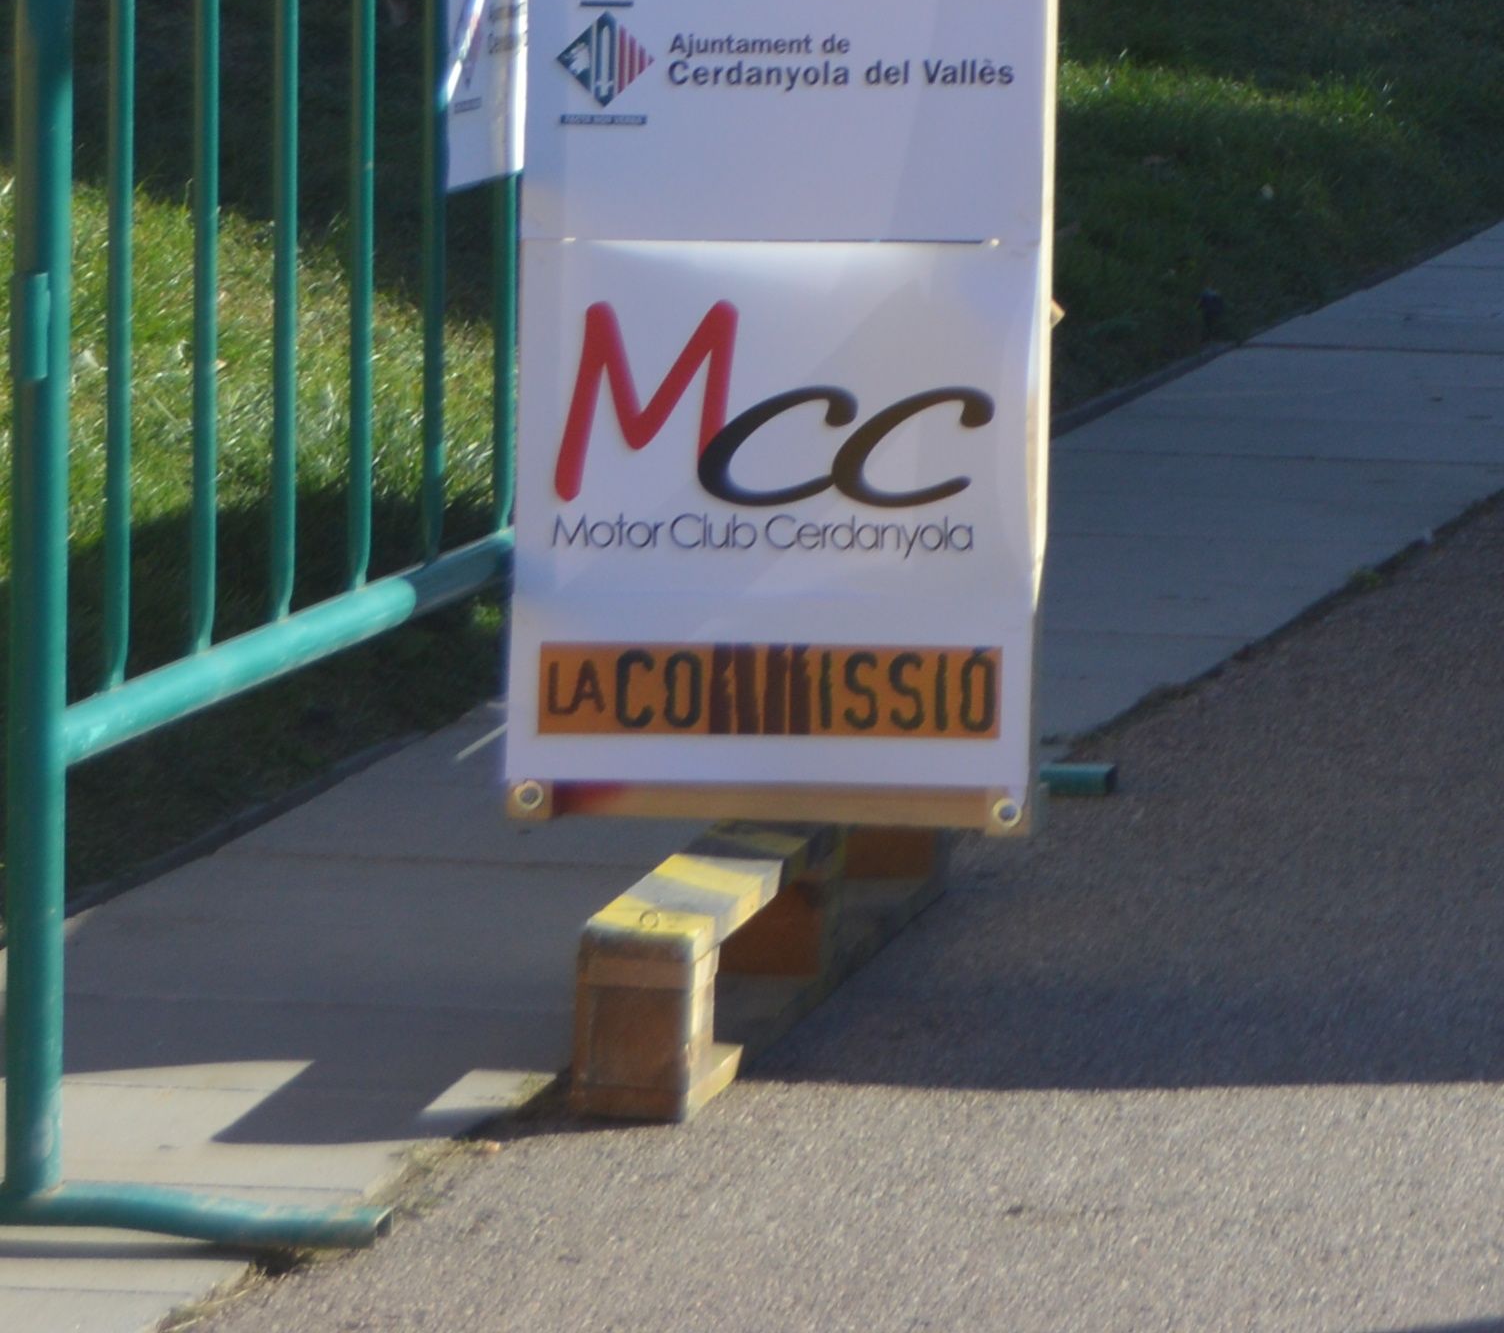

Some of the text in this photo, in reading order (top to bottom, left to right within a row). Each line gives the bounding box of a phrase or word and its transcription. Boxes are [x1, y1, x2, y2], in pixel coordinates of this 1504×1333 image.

[667, 32, 851, 59] Ajuntament de
[666, 56, 1015, 92] Cerdanyola del Vallès
[550, 512, 974, 560] Motor Club Cerdanyola
[547, 659, 606, 715] LA
